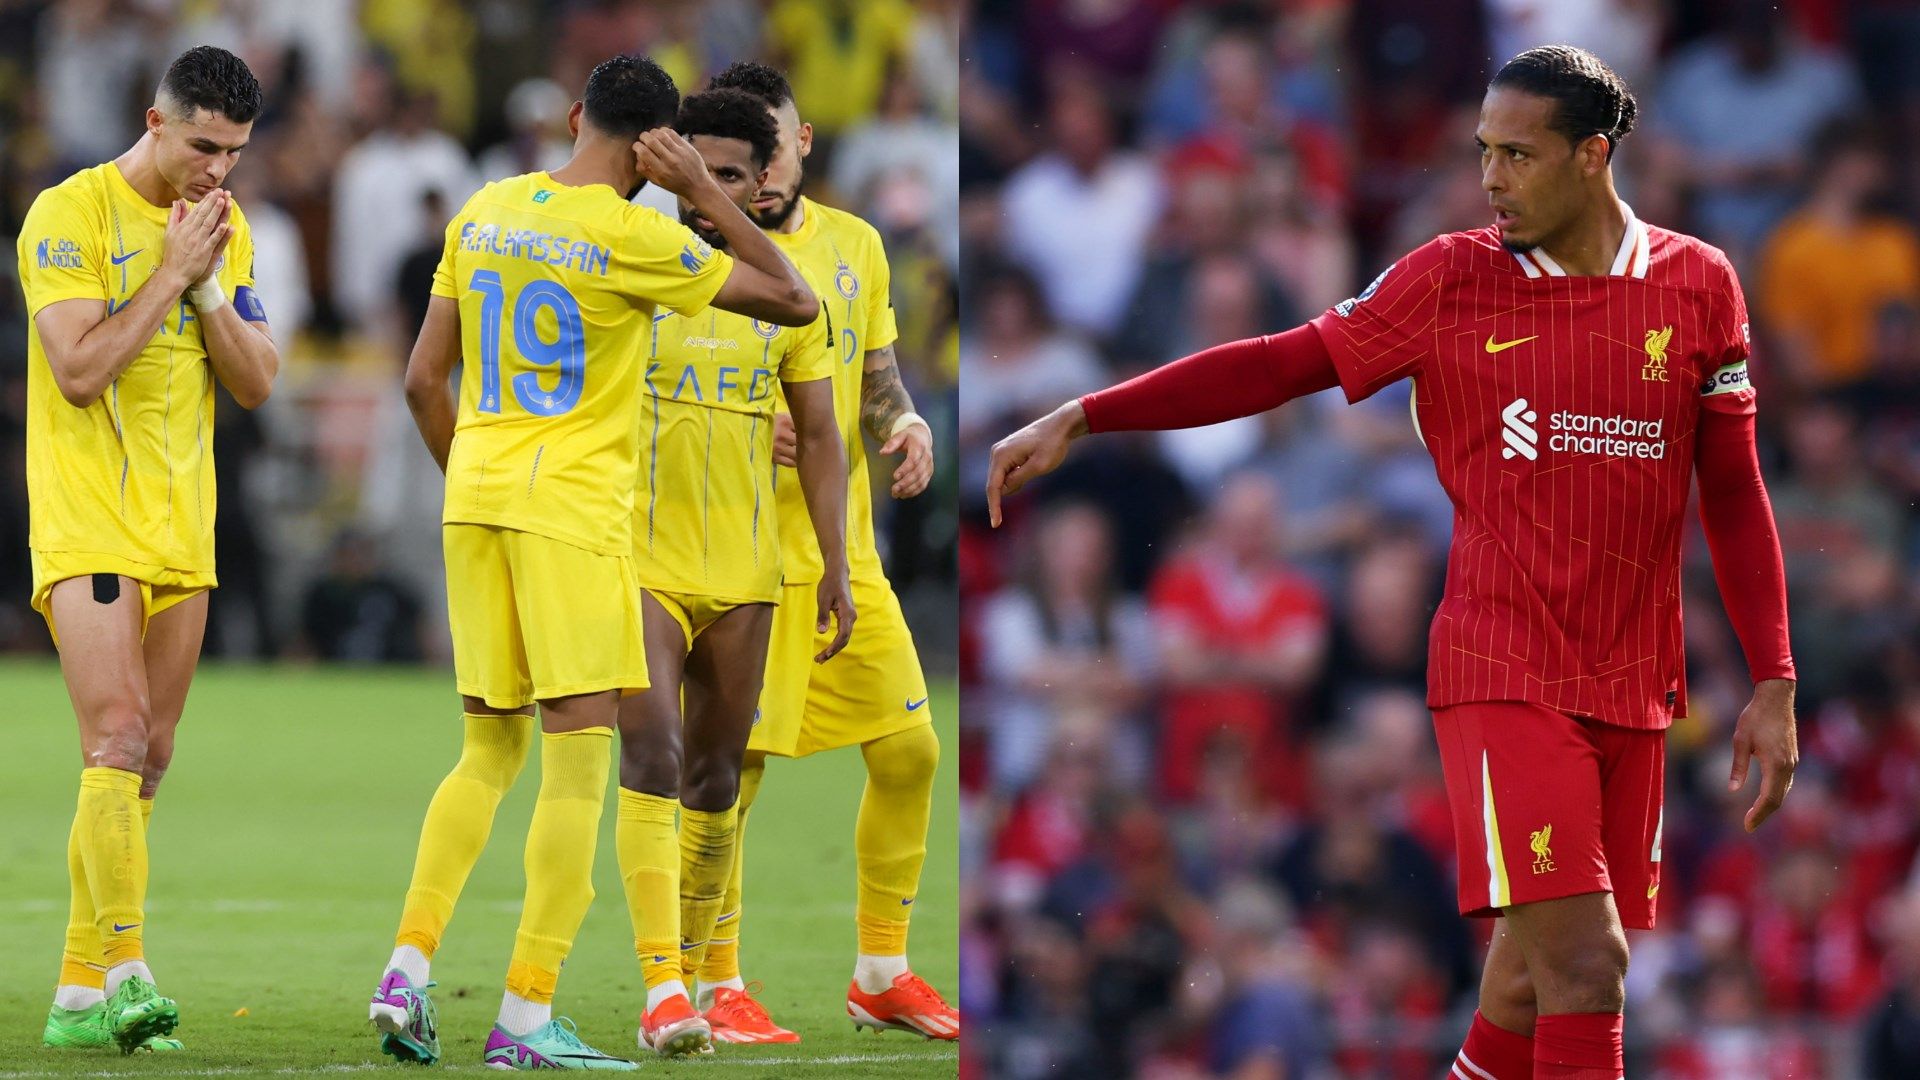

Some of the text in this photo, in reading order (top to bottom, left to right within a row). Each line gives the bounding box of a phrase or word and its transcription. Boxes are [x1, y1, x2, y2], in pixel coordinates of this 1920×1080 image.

[469, 269, 585, 417] 19
[645, 362, 771, 402] KAFD
[1549, 410, 1663, 438] standard
[1549, 432, 1665, 459] chartered
